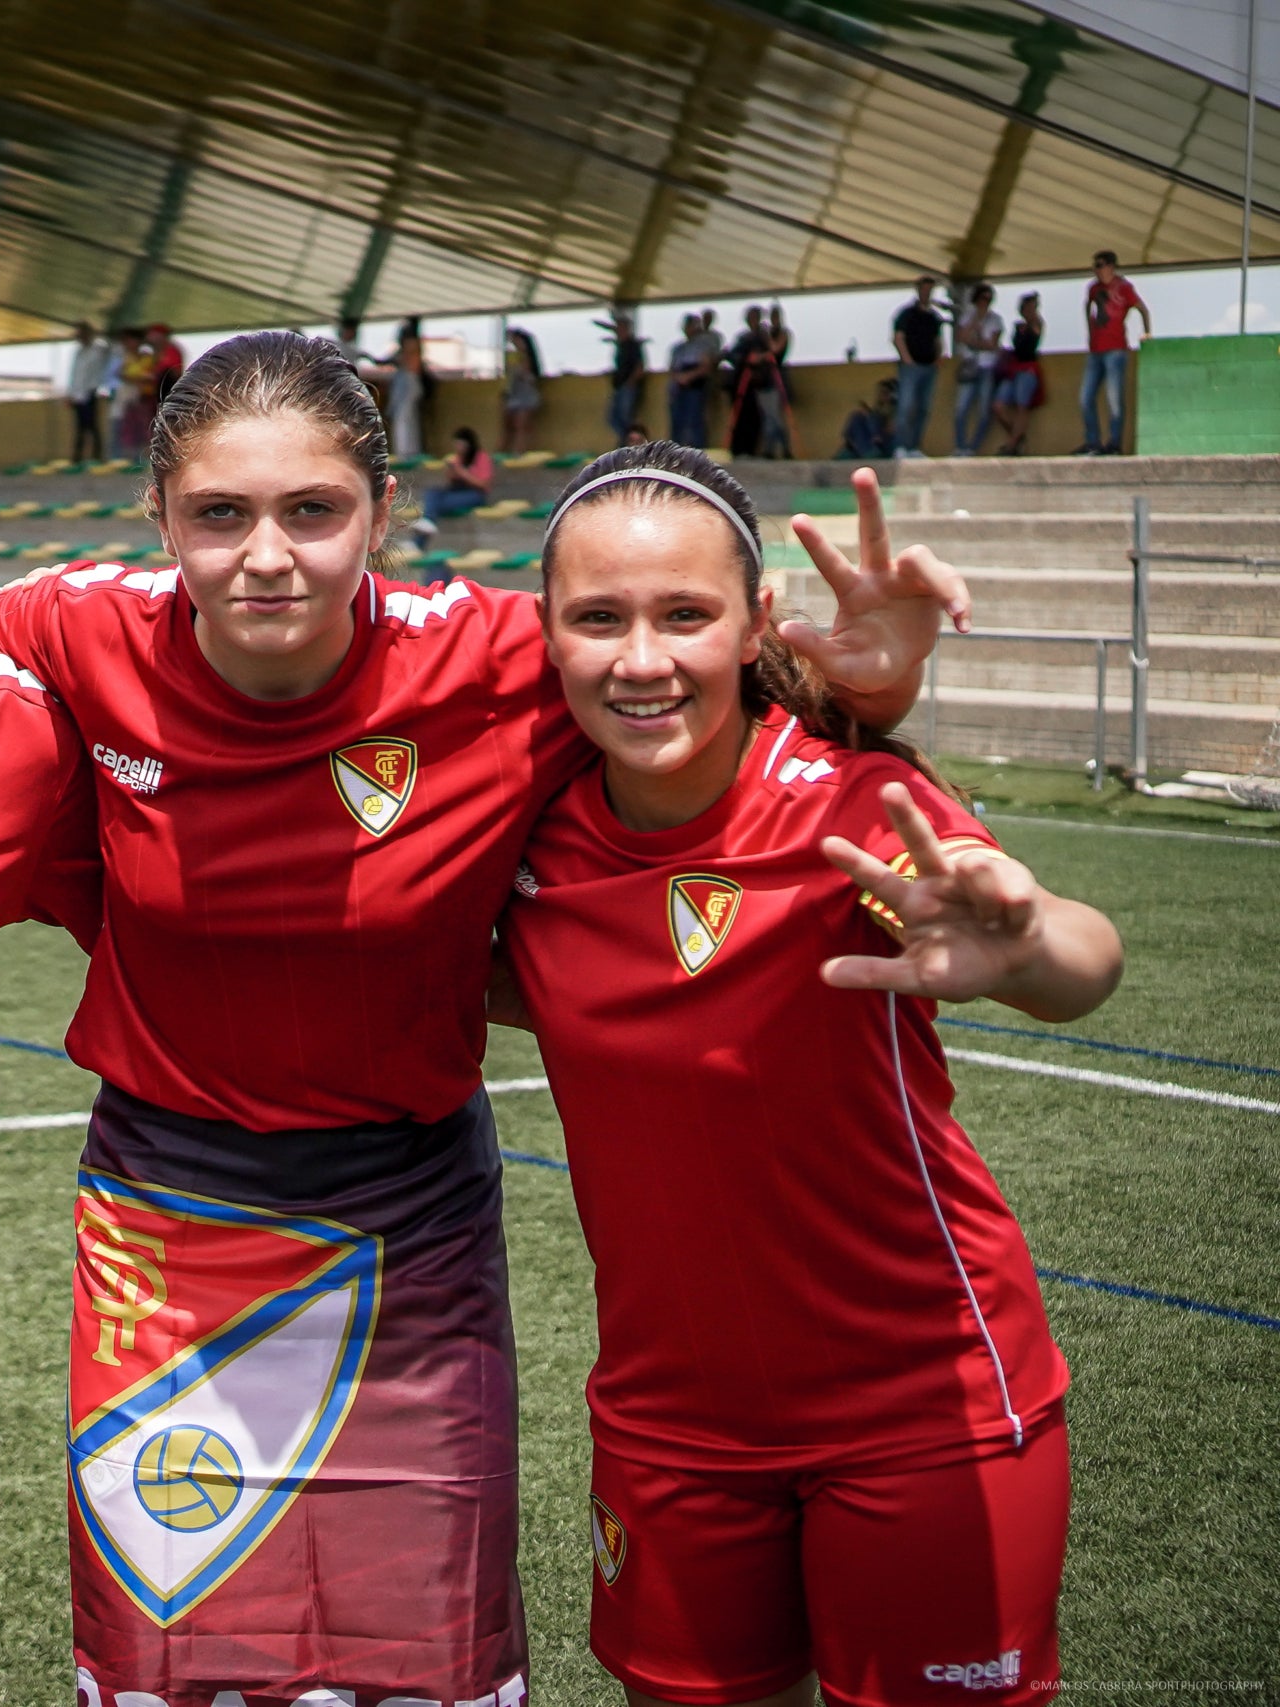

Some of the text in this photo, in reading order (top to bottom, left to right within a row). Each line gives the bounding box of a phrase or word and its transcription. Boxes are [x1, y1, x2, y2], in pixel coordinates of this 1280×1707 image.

[93, 743, 163, 787] capelli
[117, 773, 158, 795] SPORT
[924, 1649, 1021, 1688] capelli
[972, 1677, 1018, 1690] SPORT
